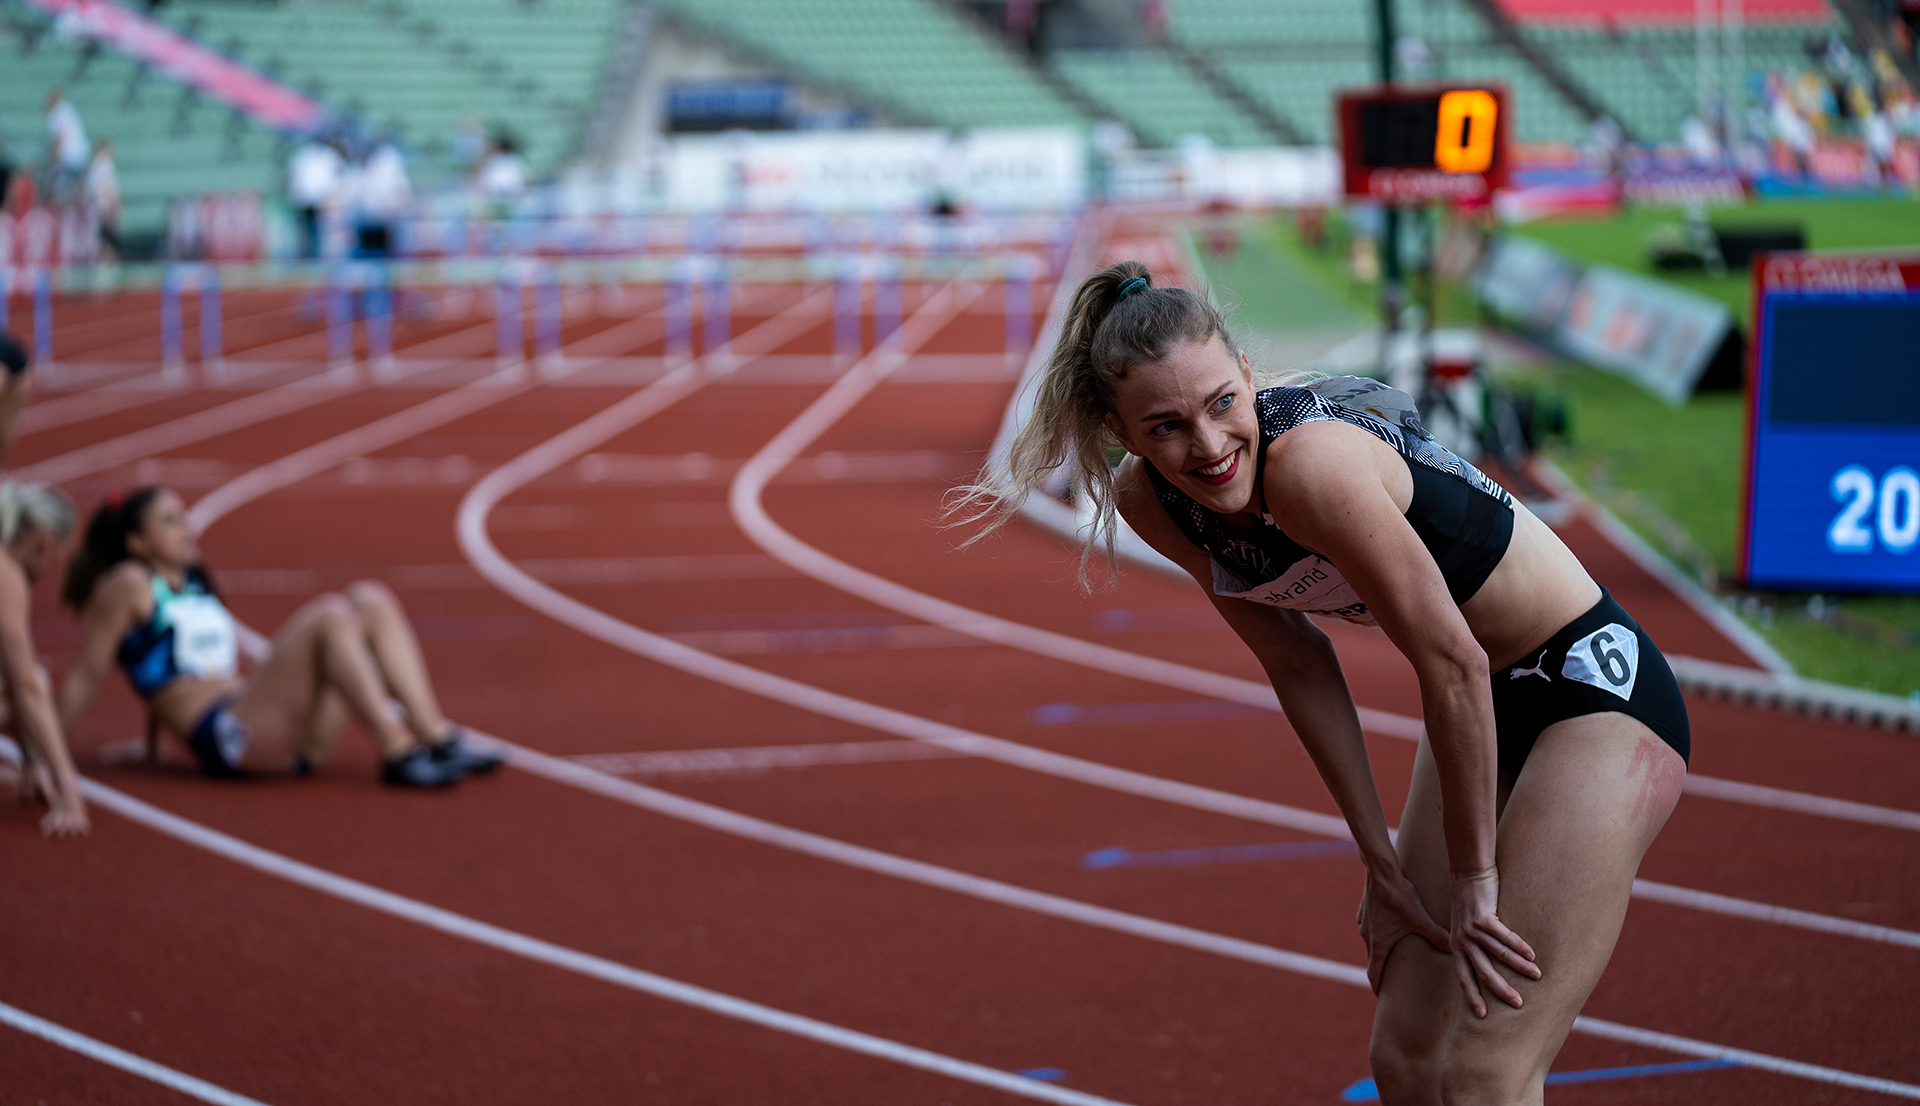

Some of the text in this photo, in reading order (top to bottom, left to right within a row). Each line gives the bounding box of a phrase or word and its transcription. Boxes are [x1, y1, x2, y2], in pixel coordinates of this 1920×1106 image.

[1434, 90, 1498, 174] 0
[1828, 465, 1920, 553] 20
[1590, 631, 1631, 687] 6
